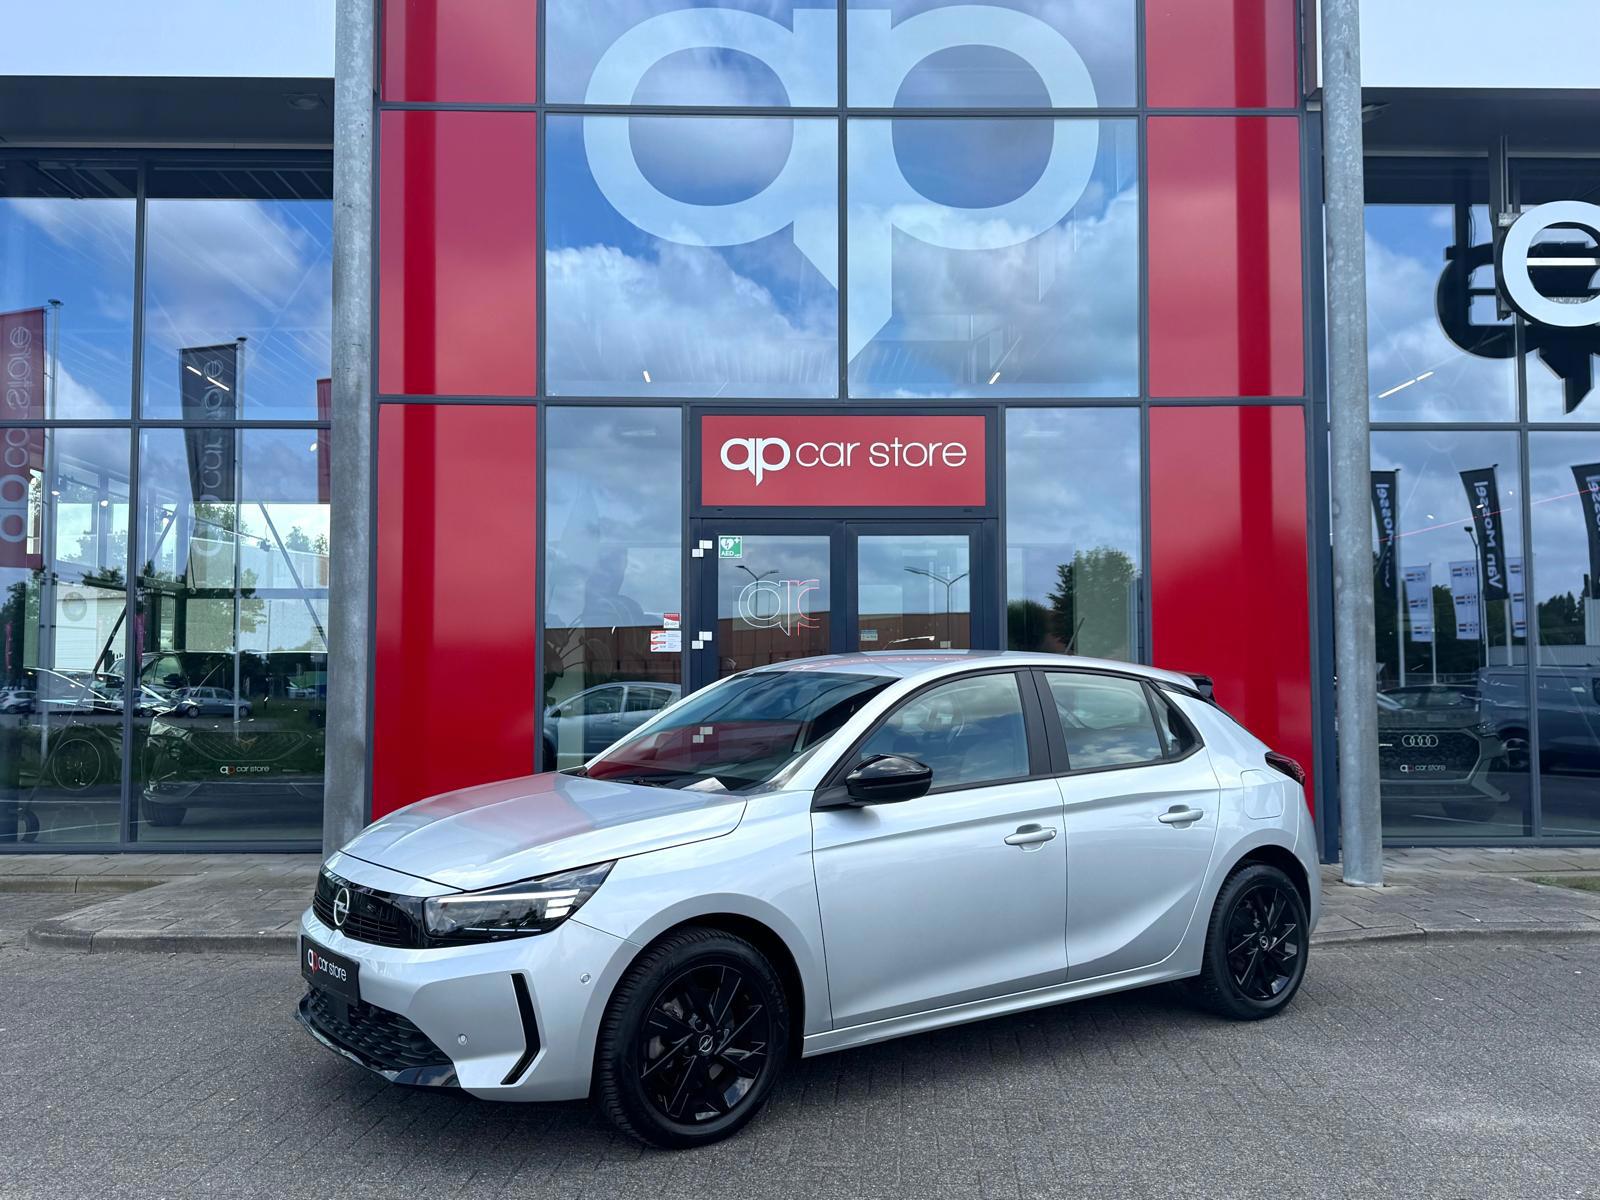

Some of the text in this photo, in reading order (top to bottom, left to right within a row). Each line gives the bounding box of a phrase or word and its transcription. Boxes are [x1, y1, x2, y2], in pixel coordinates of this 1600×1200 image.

[720, 437, 967, 486] ap car store
[329, 962, 347, 982] store
